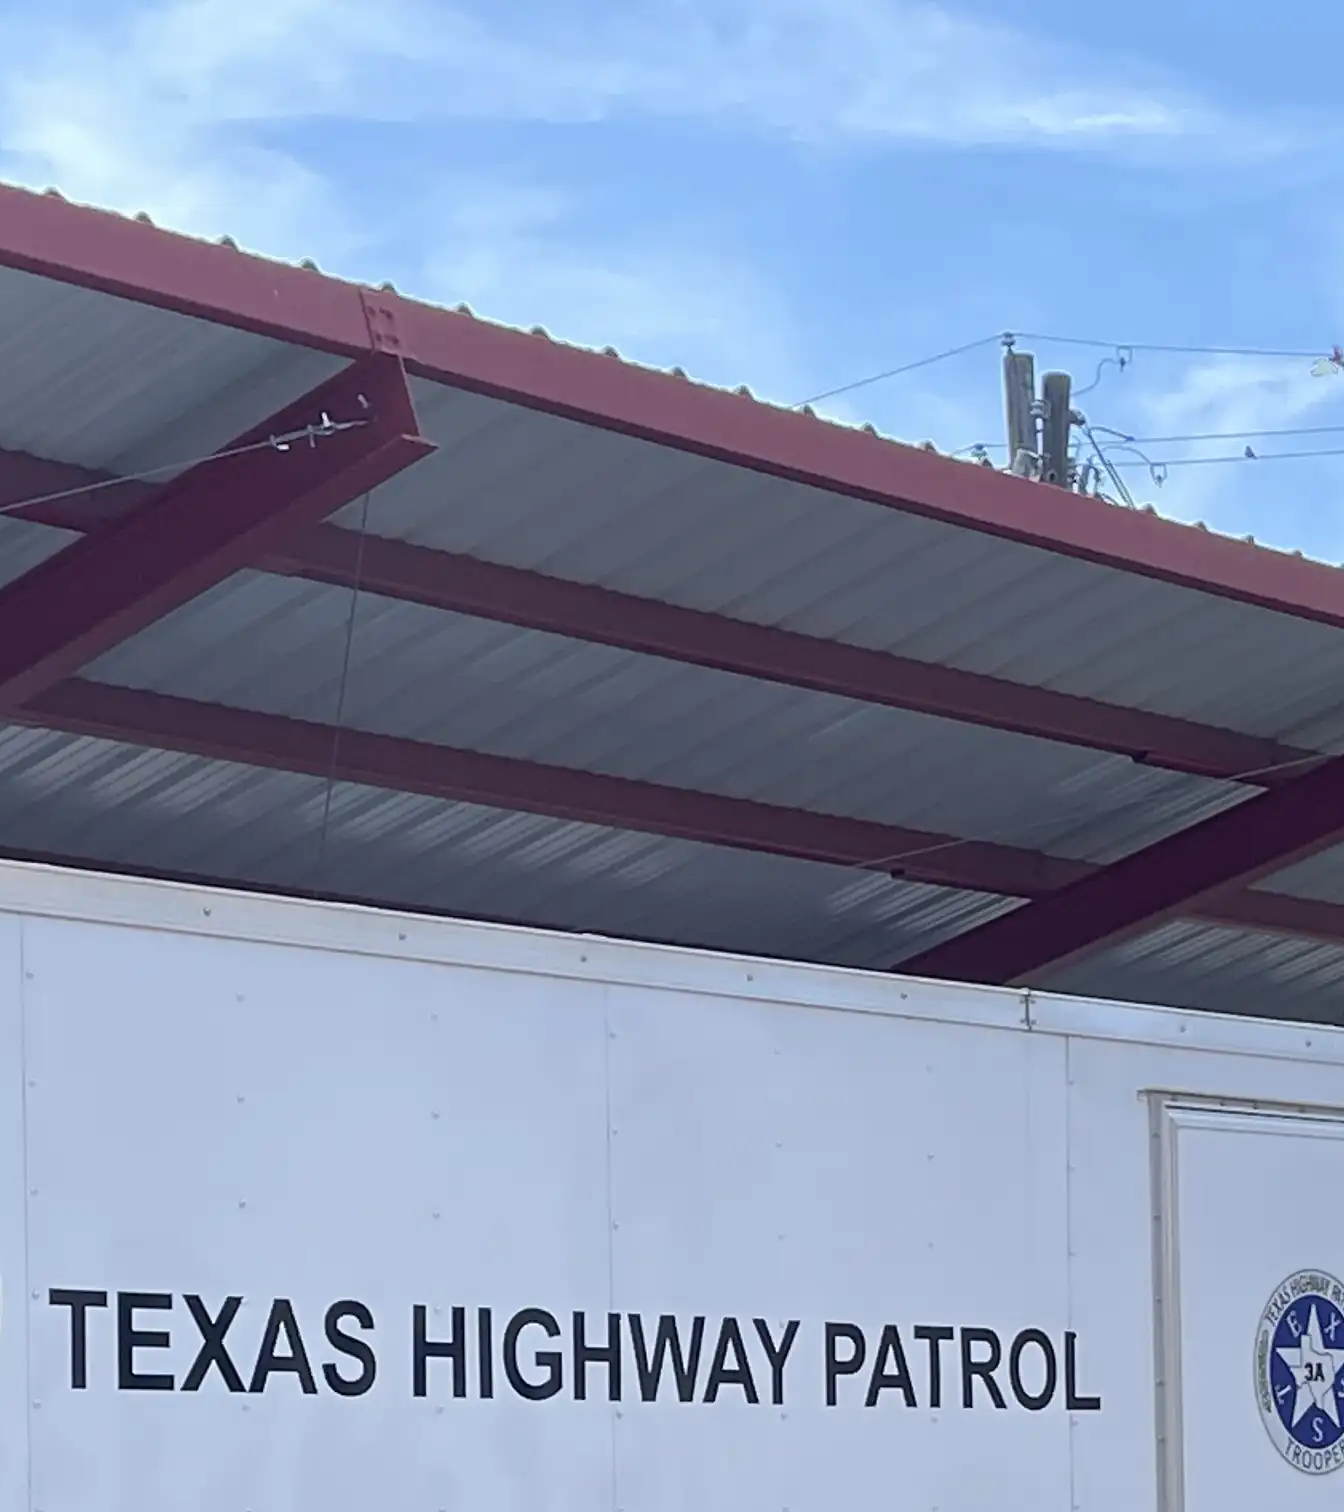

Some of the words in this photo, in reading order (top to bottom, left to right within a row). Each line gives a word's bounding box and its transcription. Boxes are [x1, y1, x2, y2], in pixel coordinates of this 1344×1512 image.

[49, 1287, 377, 1397] TEXAS
[413, 1304, 801, 1406] HIGHWAY
[824, 1320, 1102, 1411] PATROL
[1303, 1362, 1326, 1382] 3A
